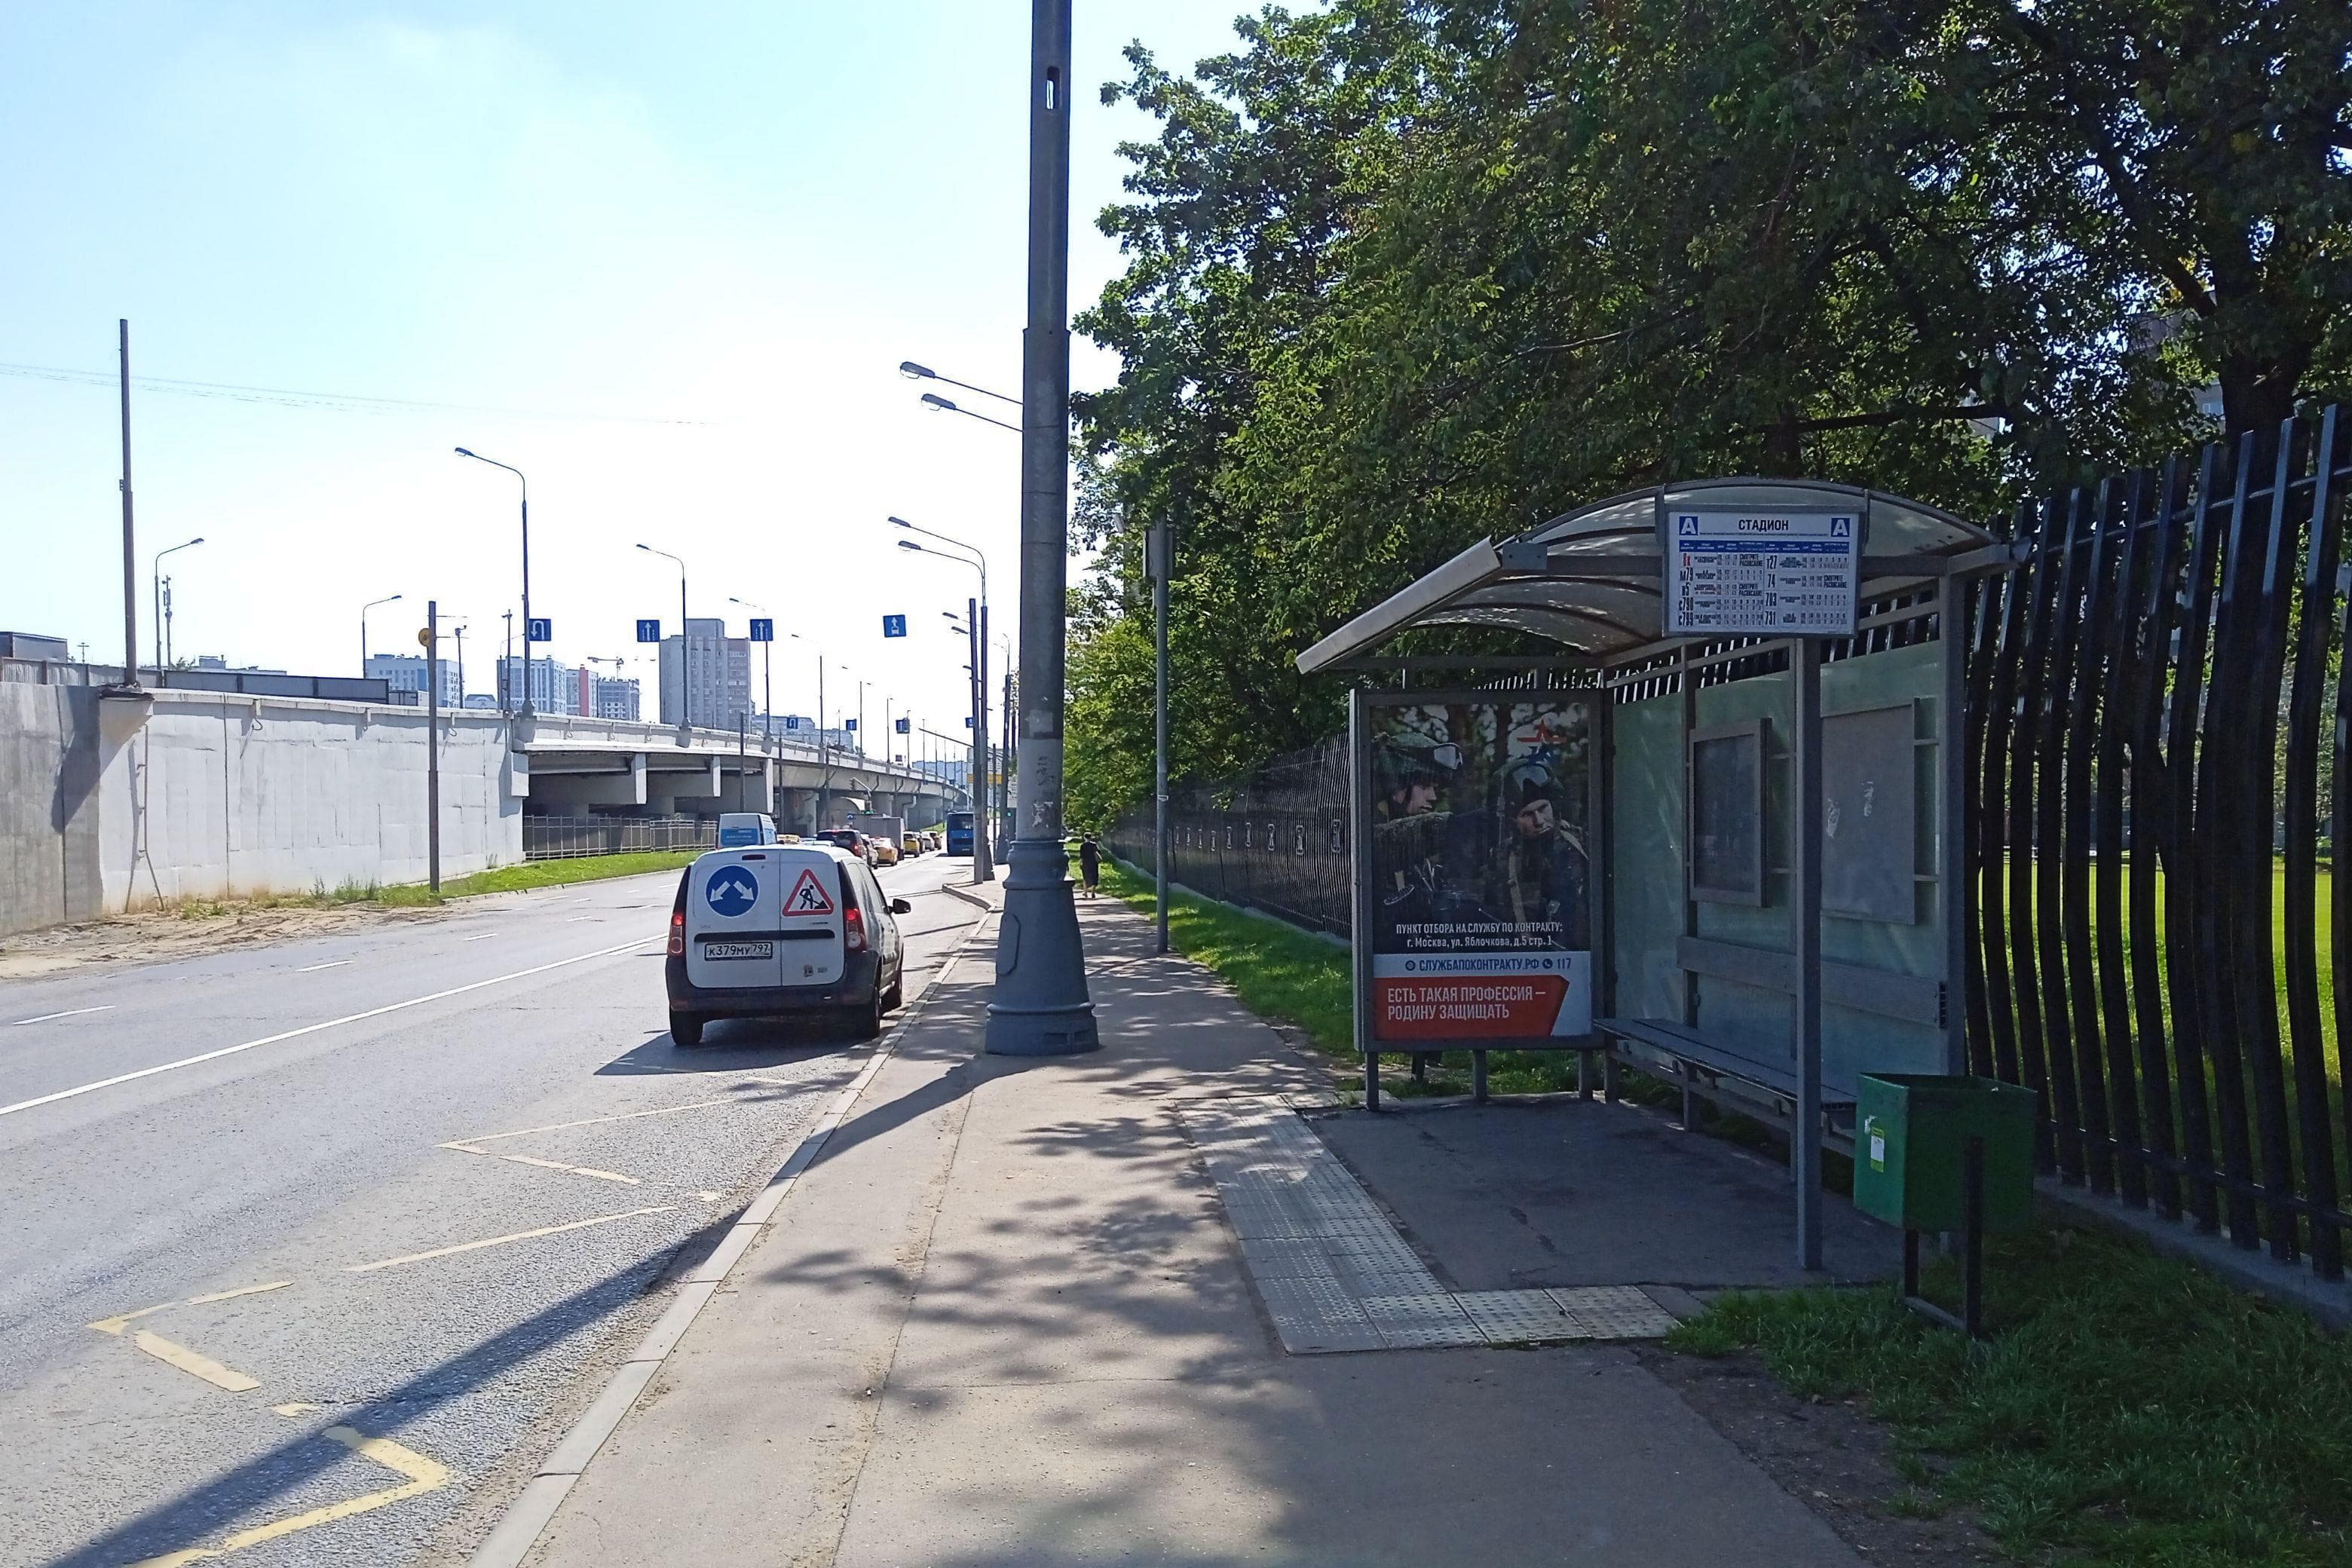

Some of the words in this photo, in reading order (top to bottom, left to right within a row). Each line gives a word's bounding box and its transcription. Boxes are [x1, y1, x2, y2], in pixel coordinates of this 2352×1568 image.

[1738, 519, 1789, 532] СТАДИОН
[1768, 574, 1775, 588] 74
[1765, 611, 1776, 625] 731
[1396, 923, 1423, 934] ПУНКТ
[1423, 923, 1454, 933] ОТБОРА
[1456, 923, 1467, 933] НА
[1468, 923, 1500, 933] СЛУЖБУ
[1502, 923, 1513, 933] ПО
[1515, 921, 1563, 933] КОНТРАКТУ:
[1407, 939, 1413, 948] г.
[1415, 937, 1450, 948] Москва,
[1451, 939, 1463, 948] ул.
[1465, 936, 1512, 947] Яблочкова,
[1529, 936, 1546, 948] стр.
[1419, 958, 1539, 971] СЛУЖБАПОКОНТРАКТУ.РФ
[1557, 957, 1572, 969] 117
[1388, 988, 1416, 1003] ЕСТЬ
[1419, 987, 1457, 1003] ТАКАЯ
[1461, 986, 1533, 1002] ПРОФЕССИЯ
[1388, 1005, 1436, 1021] РОДИНУ
[1439, 1004, 1510, 1021] ЗАЩИЩАТЬ
